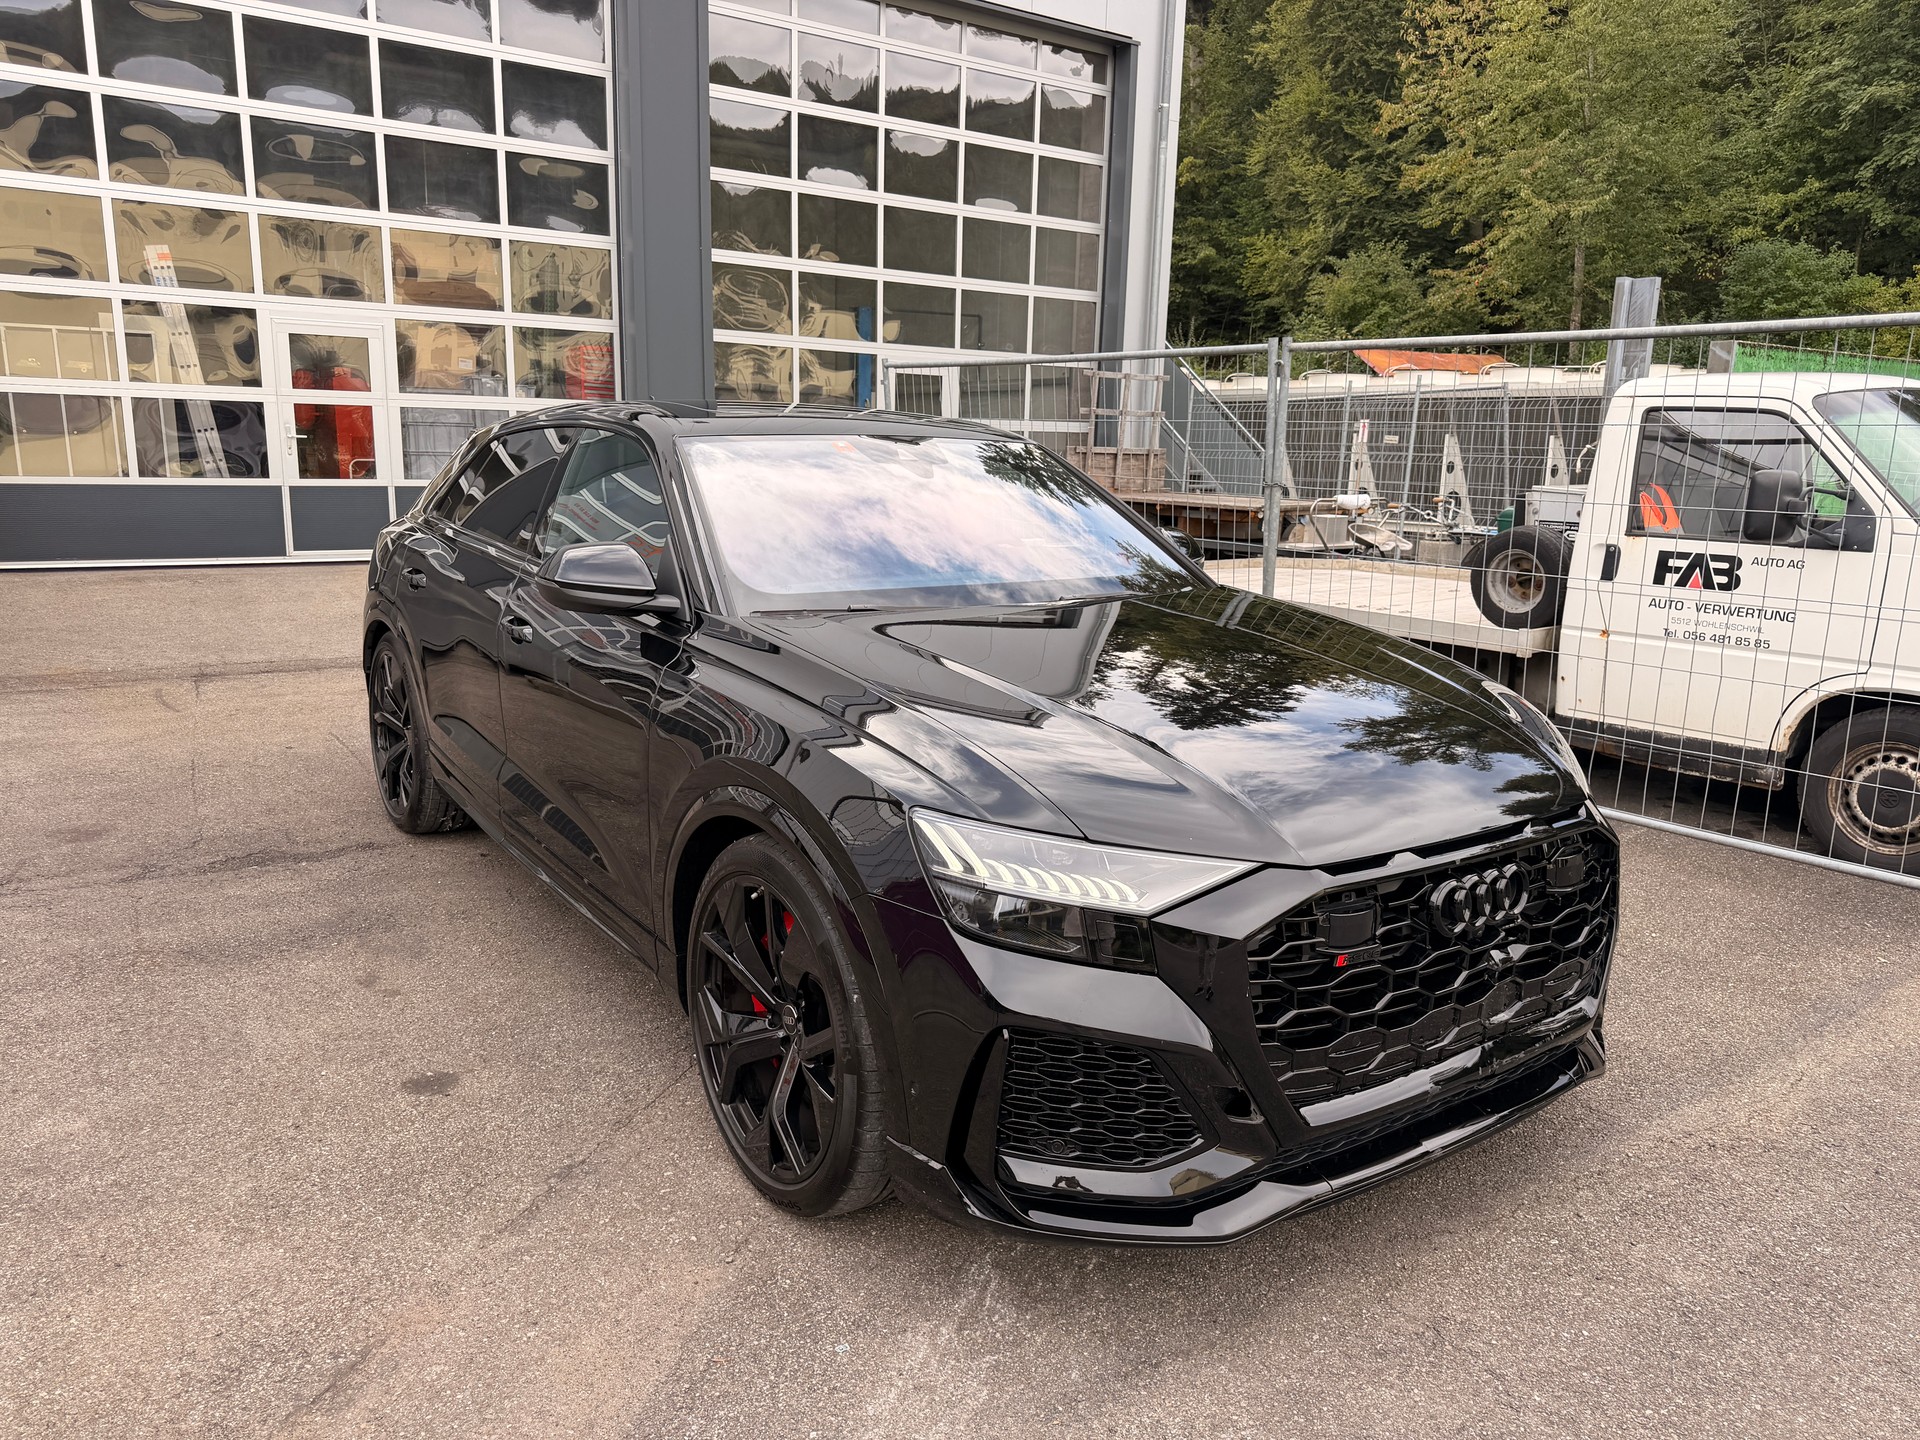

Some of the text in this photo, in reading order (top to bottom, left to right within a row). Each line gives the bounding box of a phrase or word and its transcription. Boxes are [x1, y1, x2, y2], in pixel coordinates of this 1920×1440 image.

[1652, 550, 1743, 592] FAB
[1750, 556, 1806, 570] AUTO AG
[1648, 598, 1684, 611] AUTO
[1695, 602, 1797, 623] VERWERTUNG
[1670, 617, 1765, 635] 5512 WOHLENSCHWIL
[1662, 628, 1771, 650] Tel. 056 481 85 85
